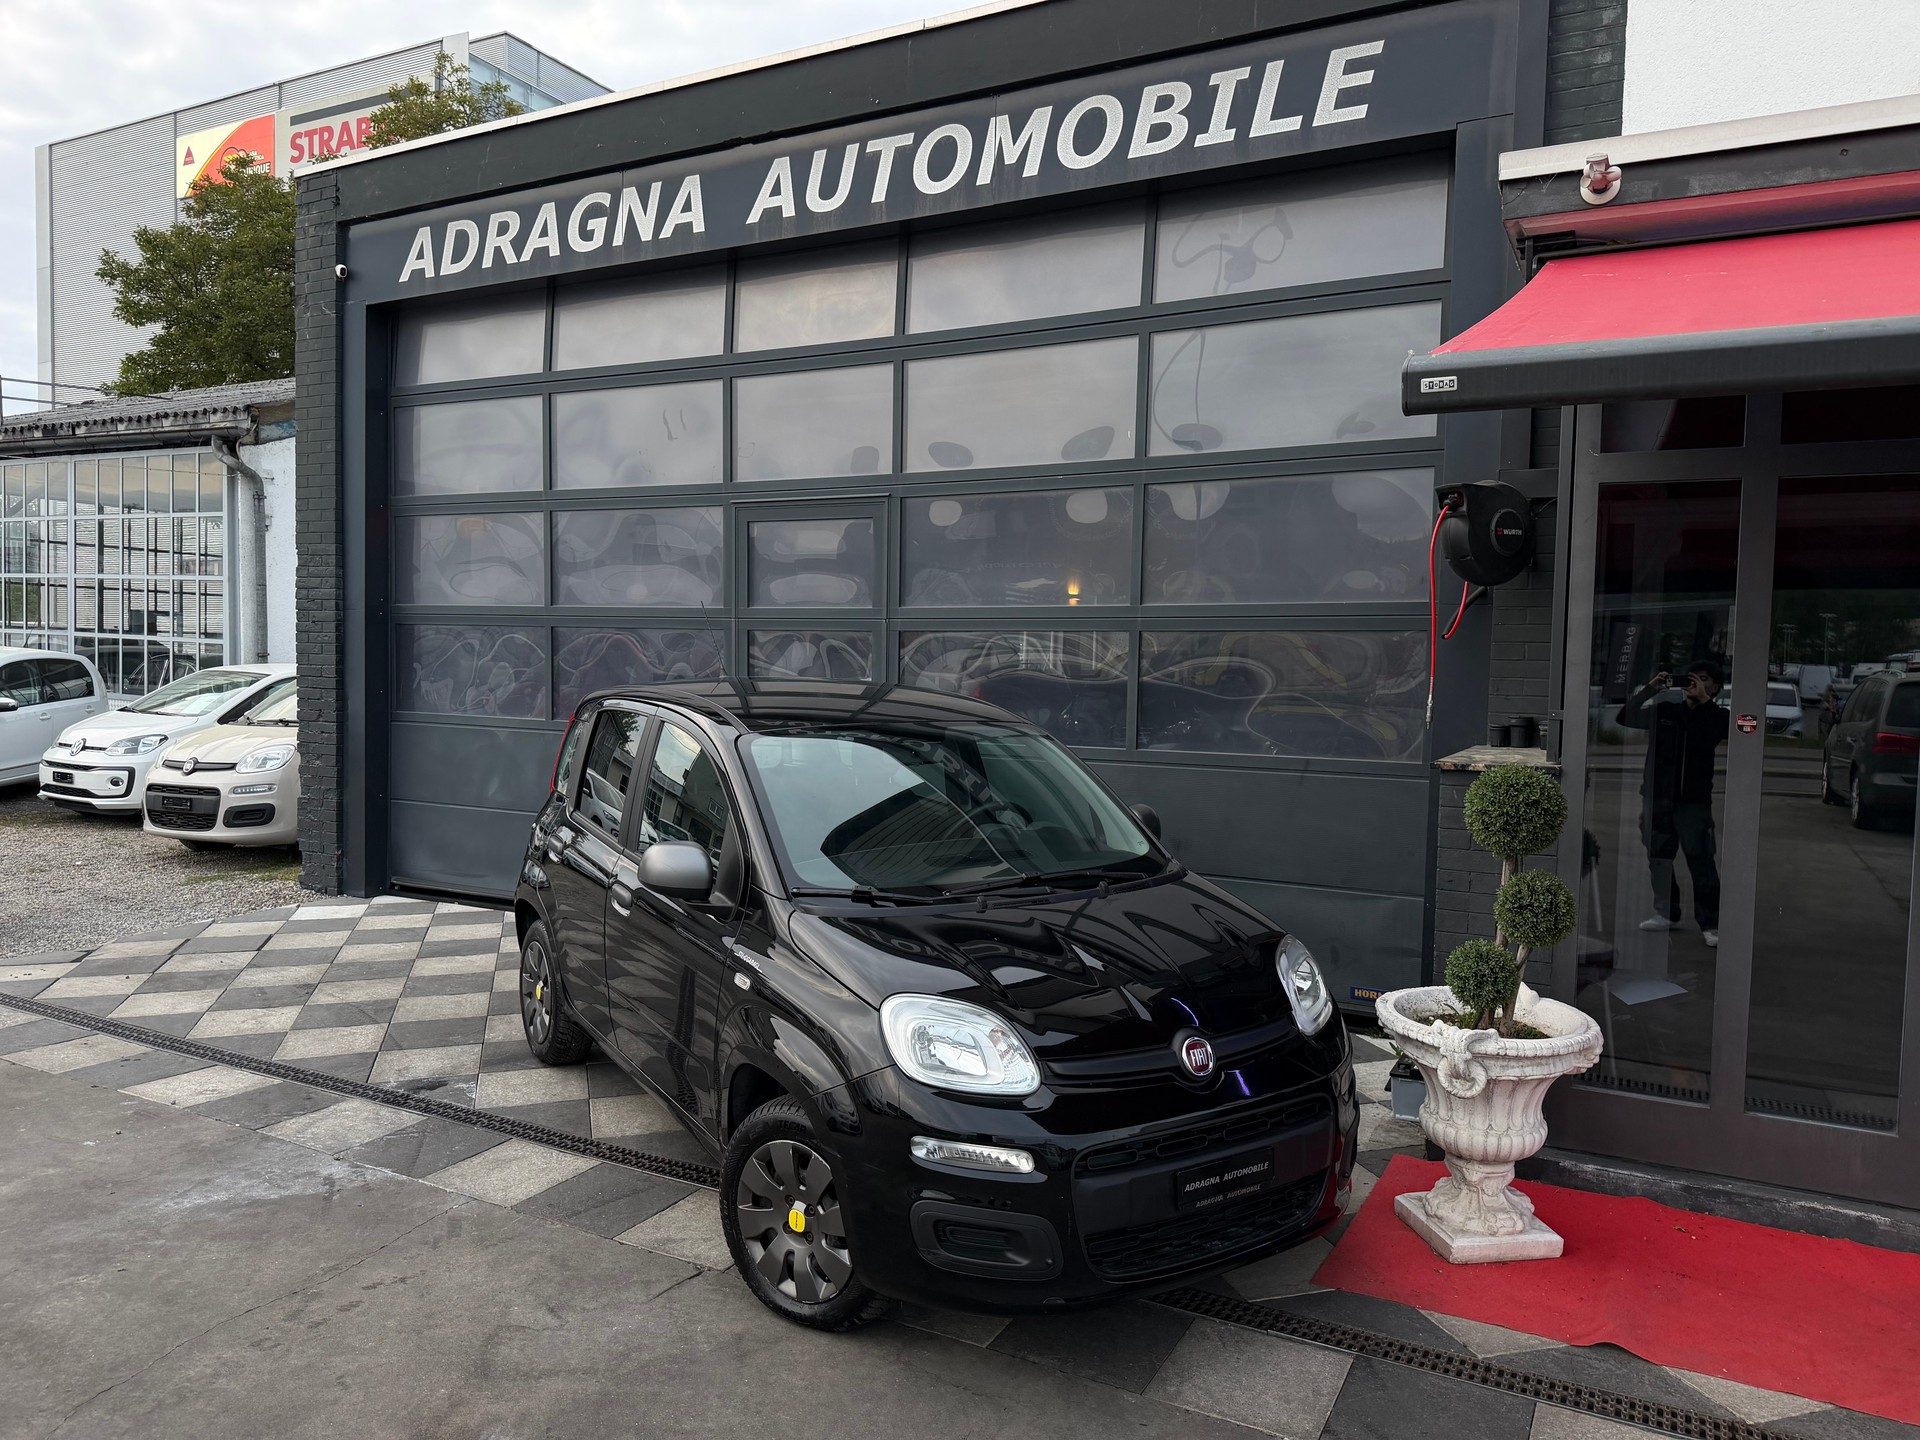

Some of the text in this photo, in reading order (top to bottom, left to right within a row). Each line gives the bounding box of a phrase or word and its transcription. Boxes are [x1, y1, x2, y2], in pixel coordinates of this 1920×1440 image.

[289, 116, 390, 164] STRAB
[399, 39, 1386, 283] ADRAGNA AUTOMOBILE
[1423, 379, 1455, 390] STOBAG
[1613, 626, 1636, 683] MERBAG
[1190, 1047, 1208, 1067] FIAT
[1184, 1161, 1270, 1193] ADRAGNA AUTOMOBILE
[1195, 1183, 1261, 1208] ADRAGNA AUTOMOBILE
